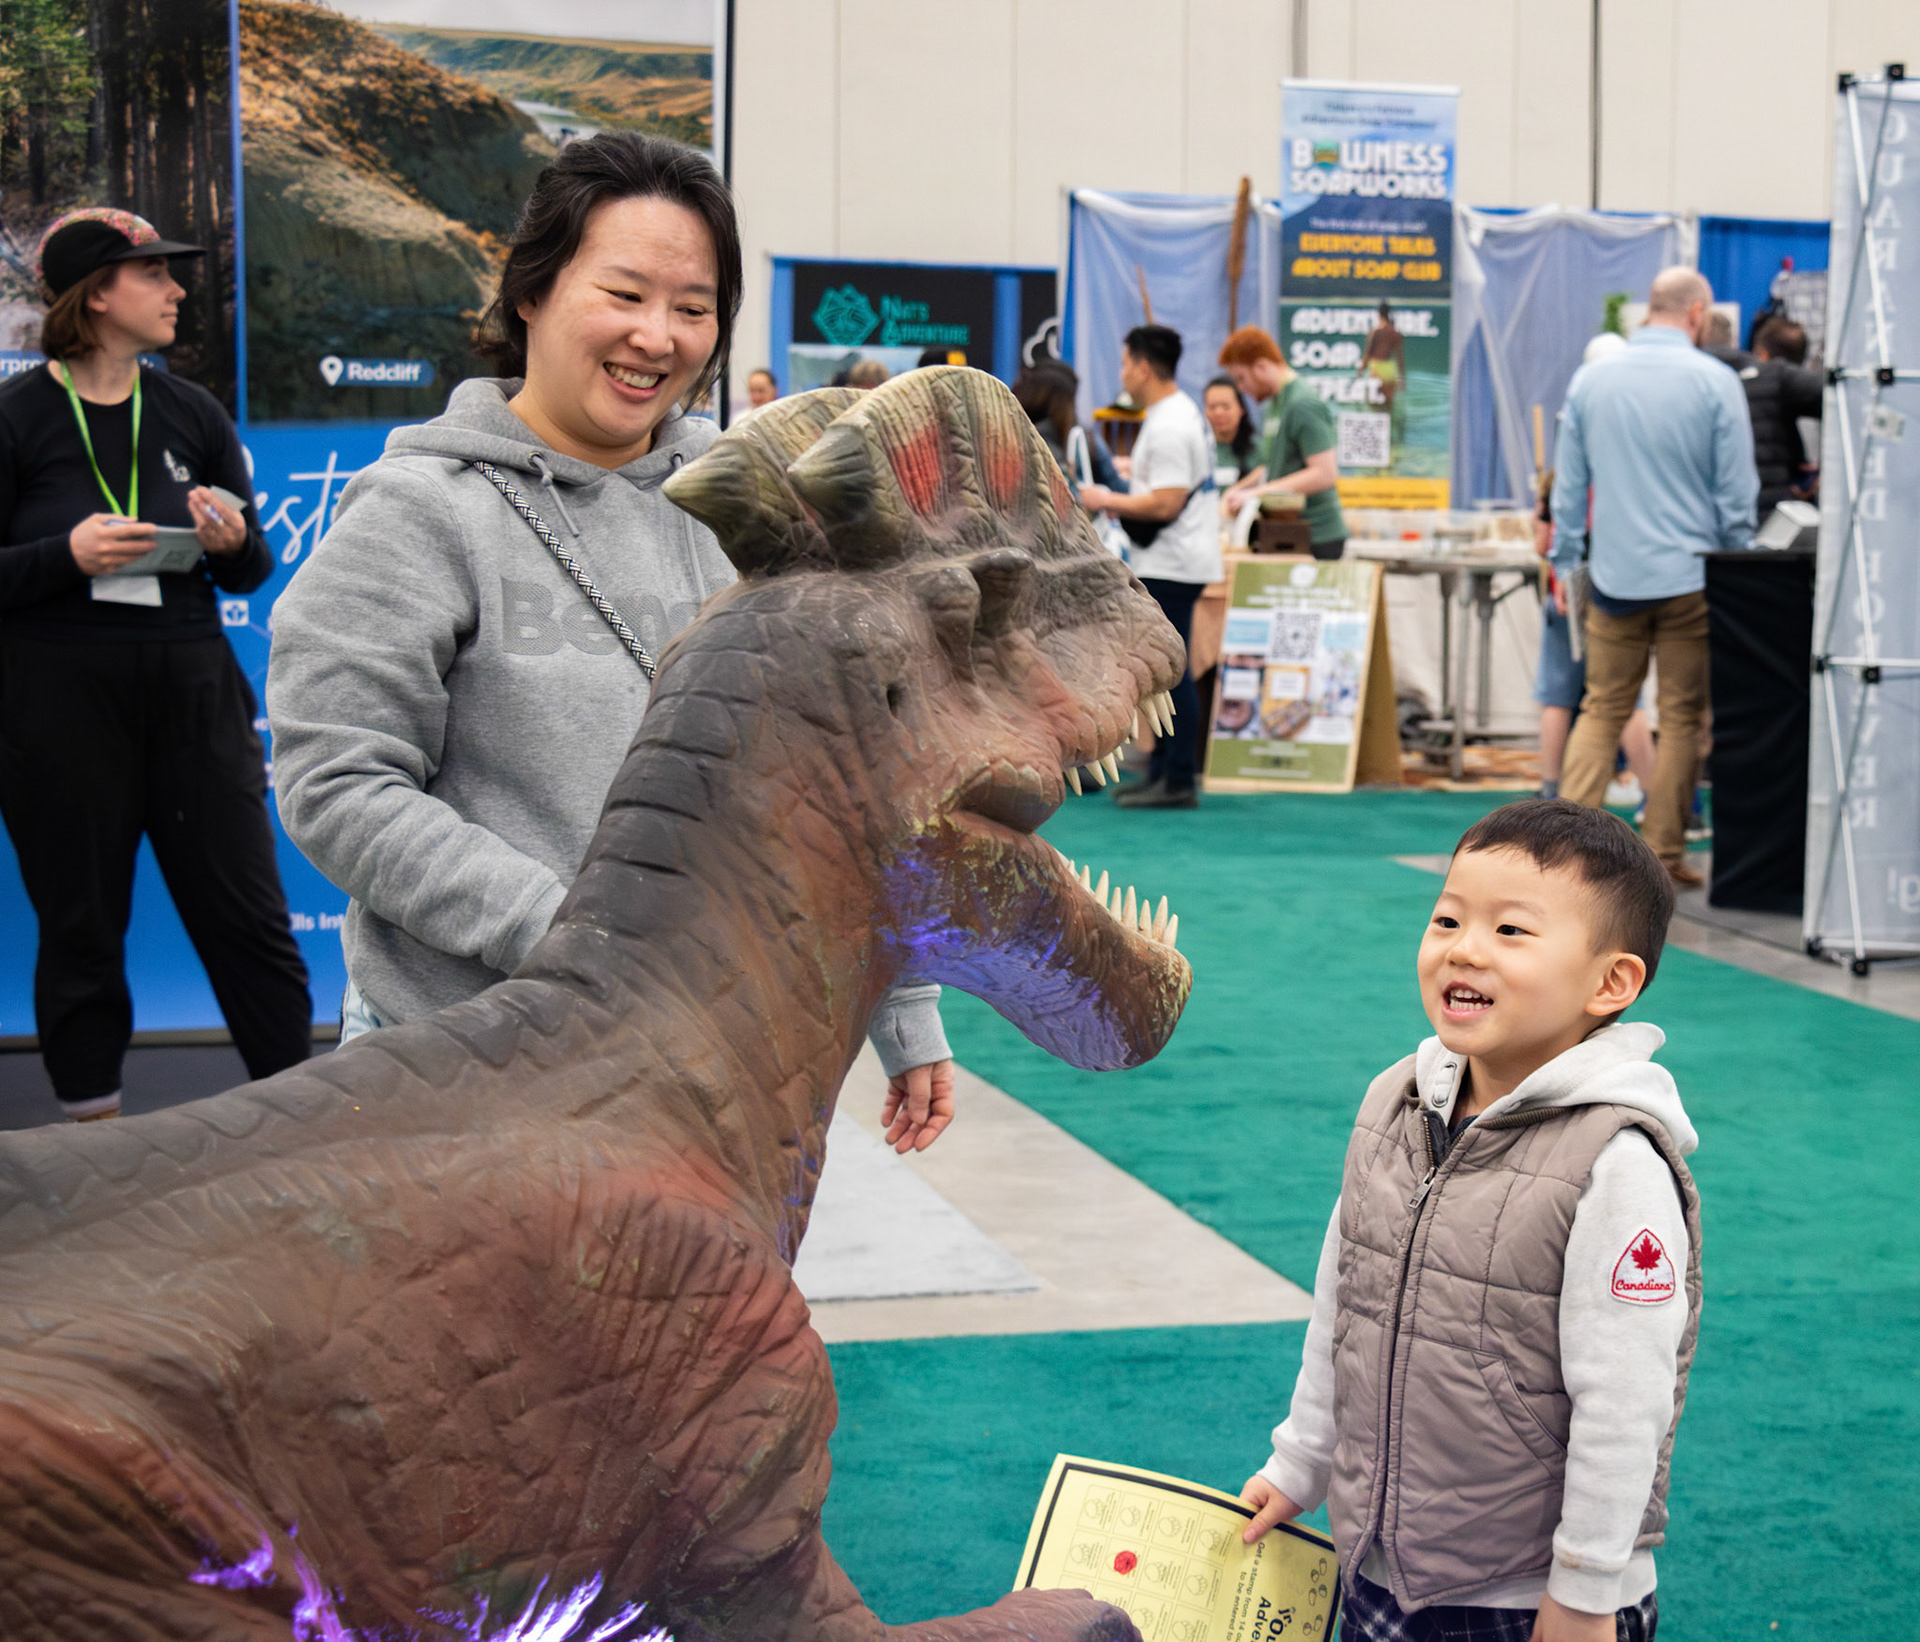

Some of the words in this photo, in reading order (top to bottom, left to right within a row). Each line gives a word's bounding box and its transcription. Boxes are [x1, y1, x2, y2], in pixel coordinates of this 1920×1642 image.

[1353, 255, 1400, 280] SOAP
[347, 361, 421, 381] Redcliff
[1256, 1542, 1266, 1558] Get
[1240, 1571, 1247, 1580] to
[1246, 1567, 1258, 1595] stamp
[1236, 1582, 1245, 1594] be
[1228, 1595, 1240, 1631] entered
[1241, 1597, 1252, 1618] from
[1238, 1621, 1246, 1630] 14
[1251, 1596, 1271, 1642] Adve
